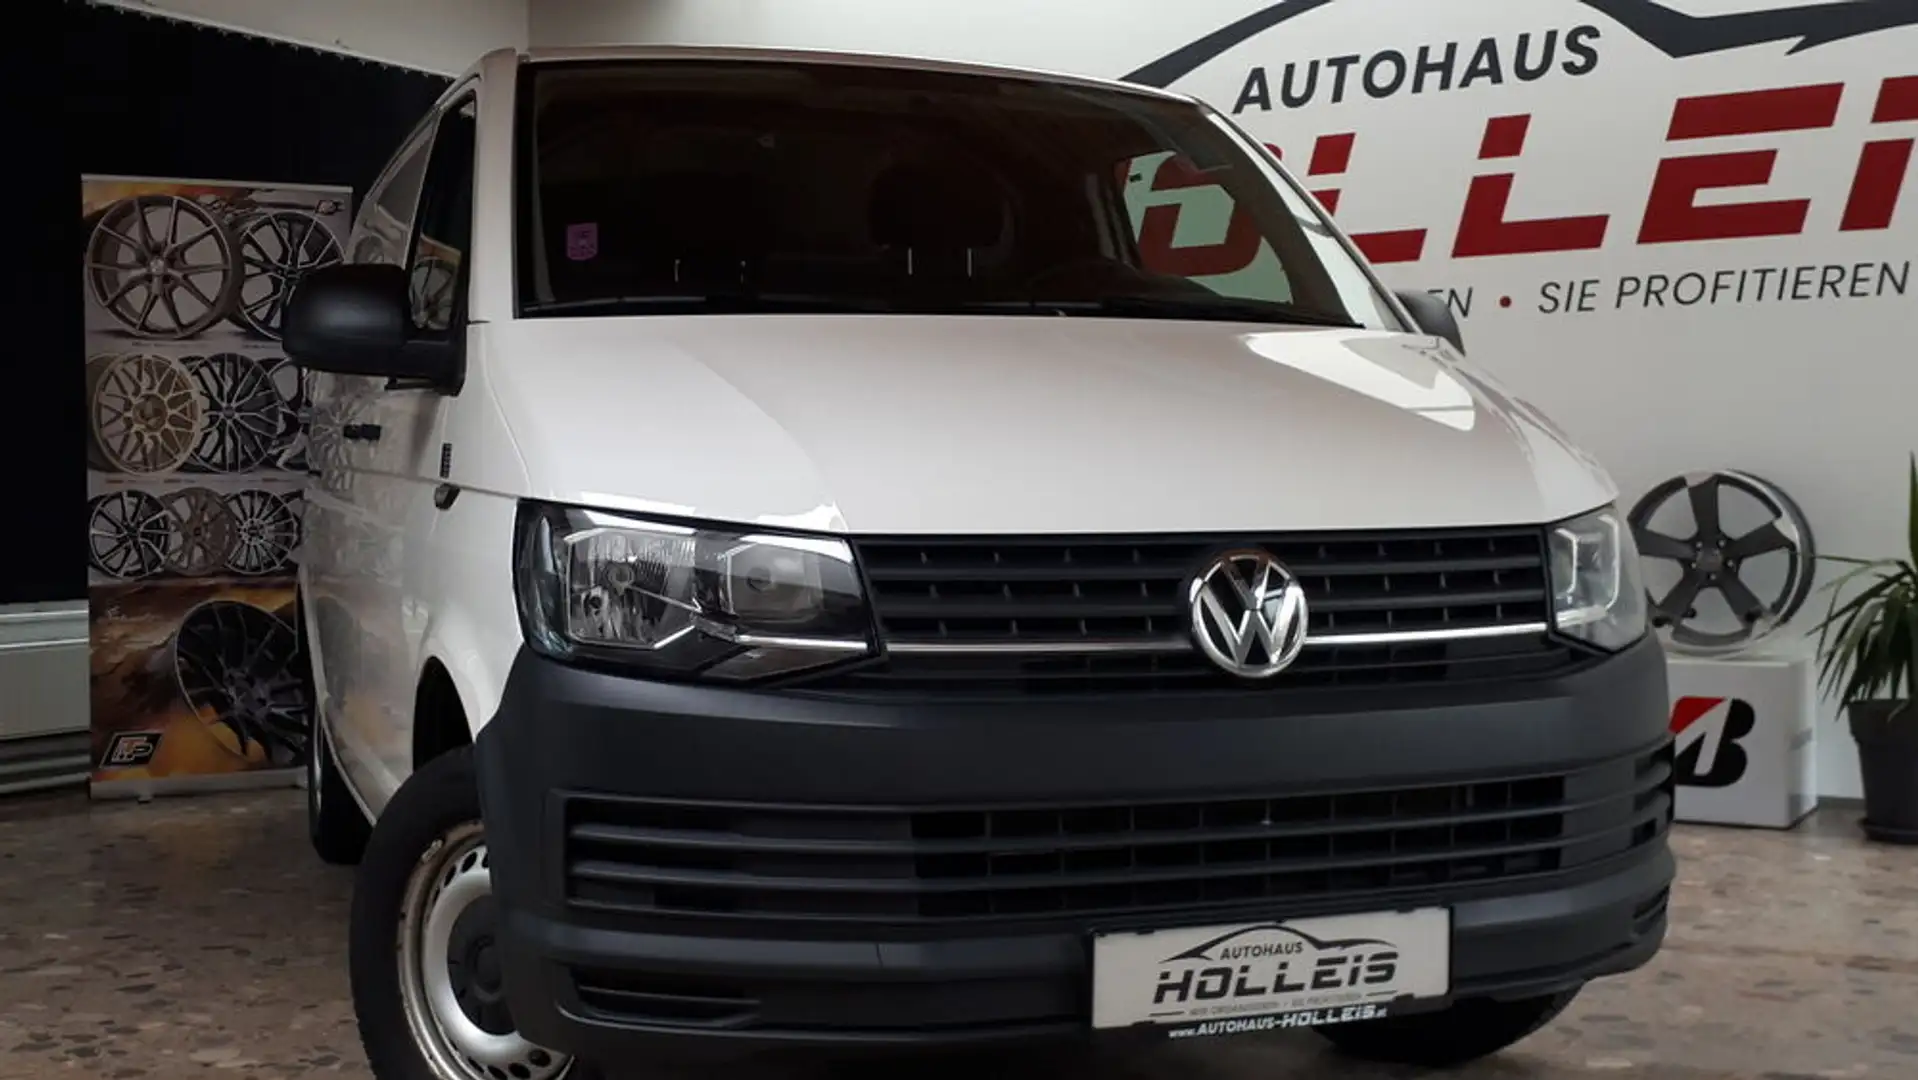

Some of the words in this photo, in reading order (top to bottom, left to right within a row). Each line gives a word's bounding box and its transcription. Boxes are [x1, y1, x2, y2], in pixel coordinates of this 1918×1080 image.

[1231, 24, 1600, 115] AUTOHAUS
[1538, 279, 1600, 314] SIE
[1614, 260, 1911, 309] PROFITIEREN
[1219, 941, 1304, 960] AUTOHAUS
[1153, 951, 1399, 1005] HOLLEIS
